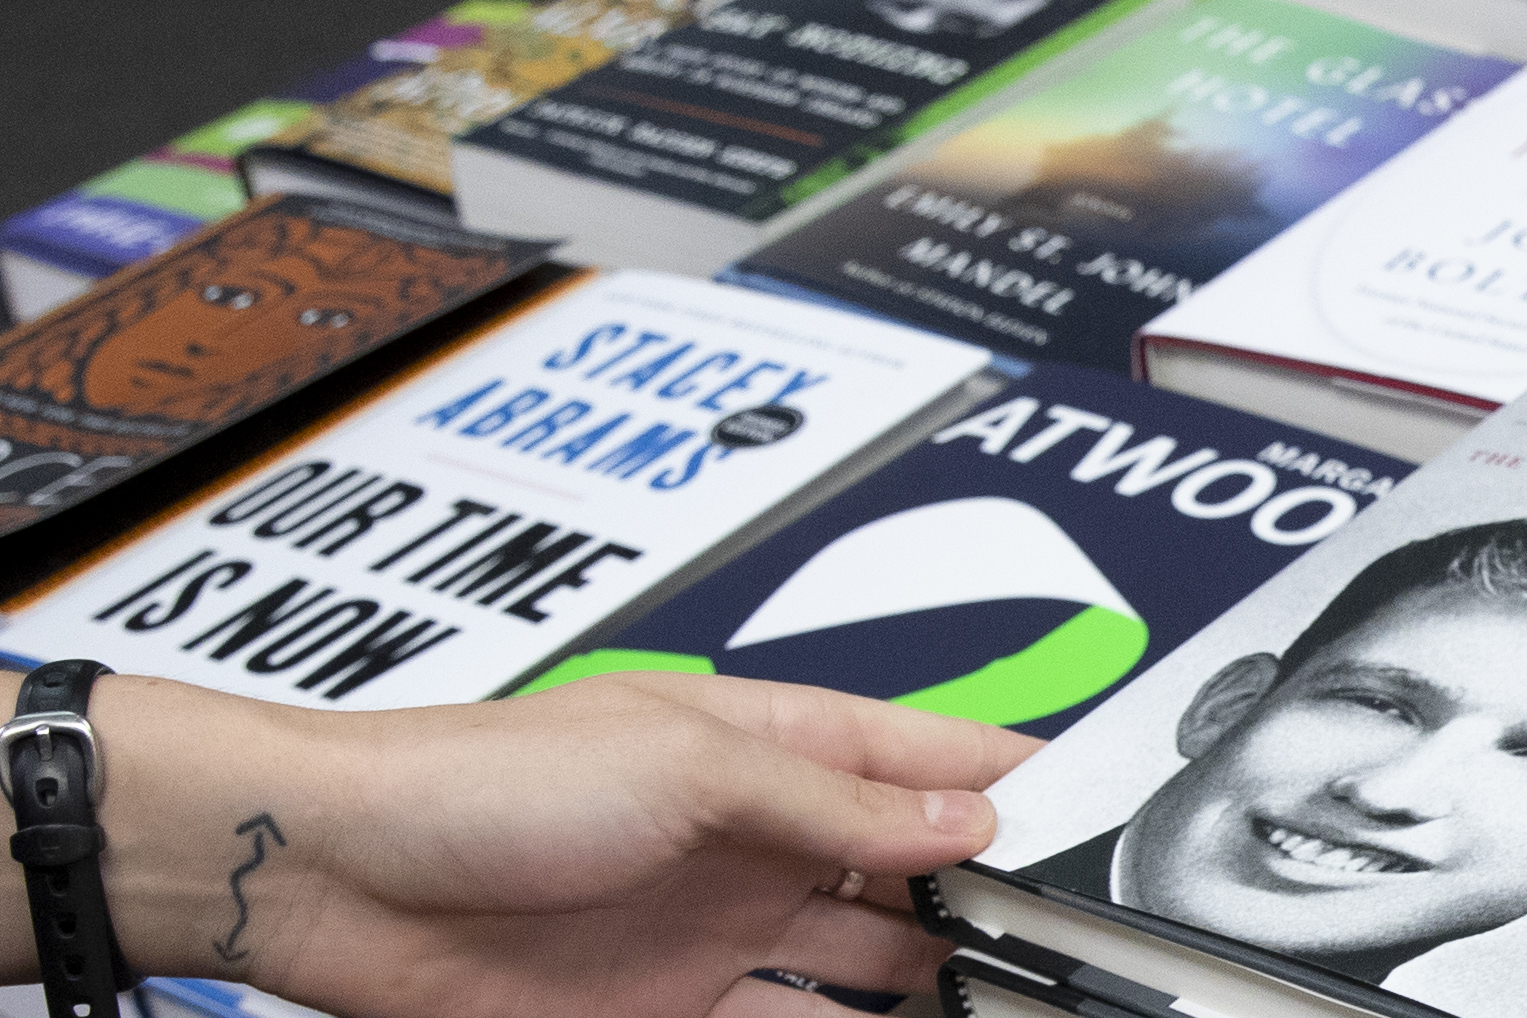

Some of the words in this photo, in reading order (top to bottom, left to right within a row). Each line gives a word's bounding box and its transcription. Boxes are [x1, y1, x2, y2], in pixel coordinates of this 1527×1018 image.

[413, 378, 742, 494] ABRAMS
[543, 322, 835, 418] STACEY
[931, 395, 1358, 547] ATWOO
[1467, 448, 1527, 473] THE
[206, 454, 424, 562] OUR
[366, 497, 648, 628] TIME
[92, 547, 258, 635] IS
[181, 575, 464, 703] NOW
